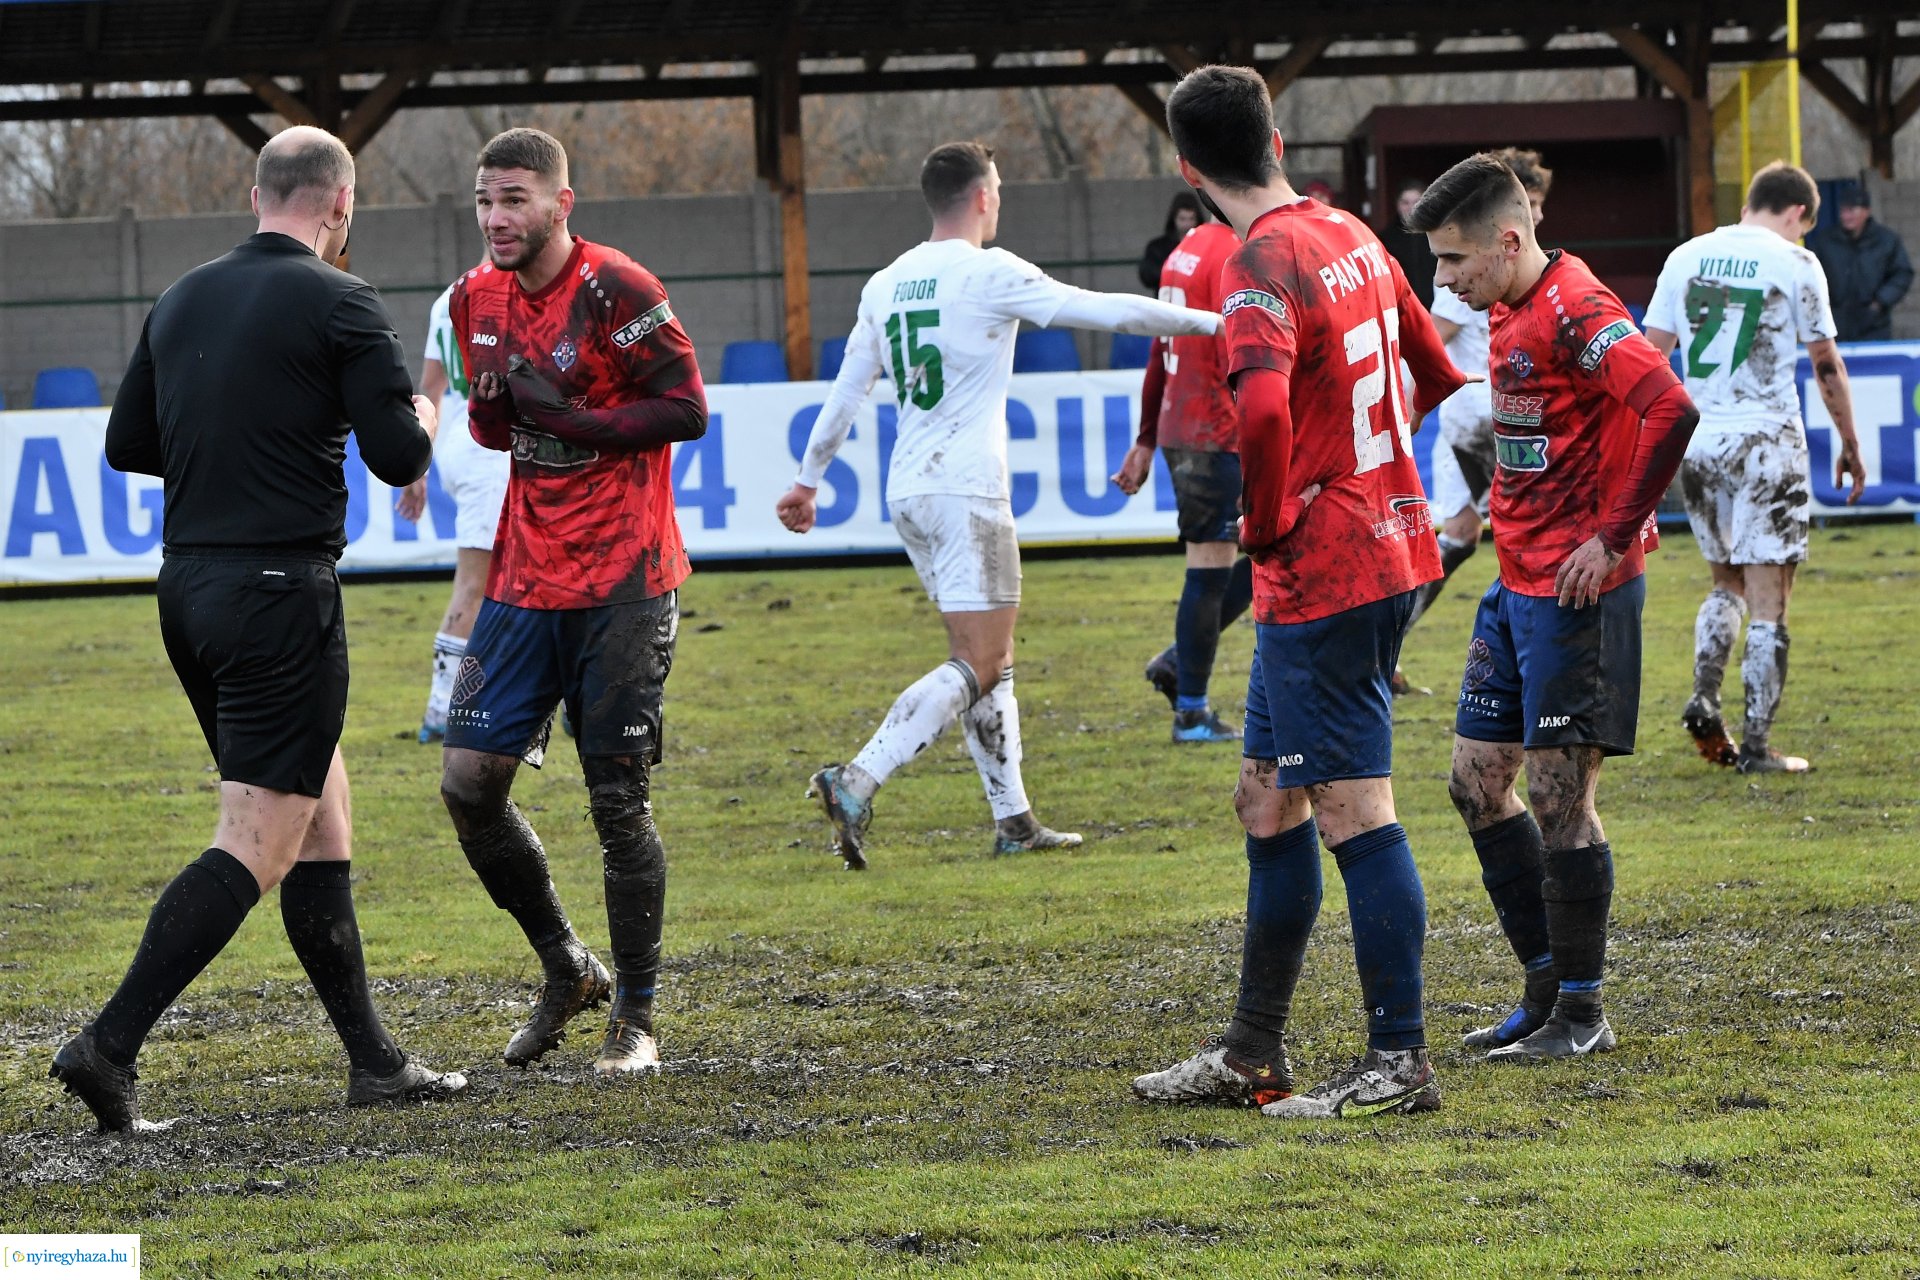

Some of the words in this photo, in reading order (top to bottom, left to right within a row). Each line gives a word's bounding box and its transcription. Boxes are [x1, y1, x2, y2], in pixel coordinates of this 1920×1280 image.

[1700, 256, 1759, 279] VITÁLIS
[893, 278, 937, 303] FODOR
[472, 333, 498, 347] JAKO
[1685, 283, 1764, 379] 27
[885, 309, 944, 411] 15
[622, 724, 649, 737] JAKO
[1538, 715, 1571, 728] JAKO
